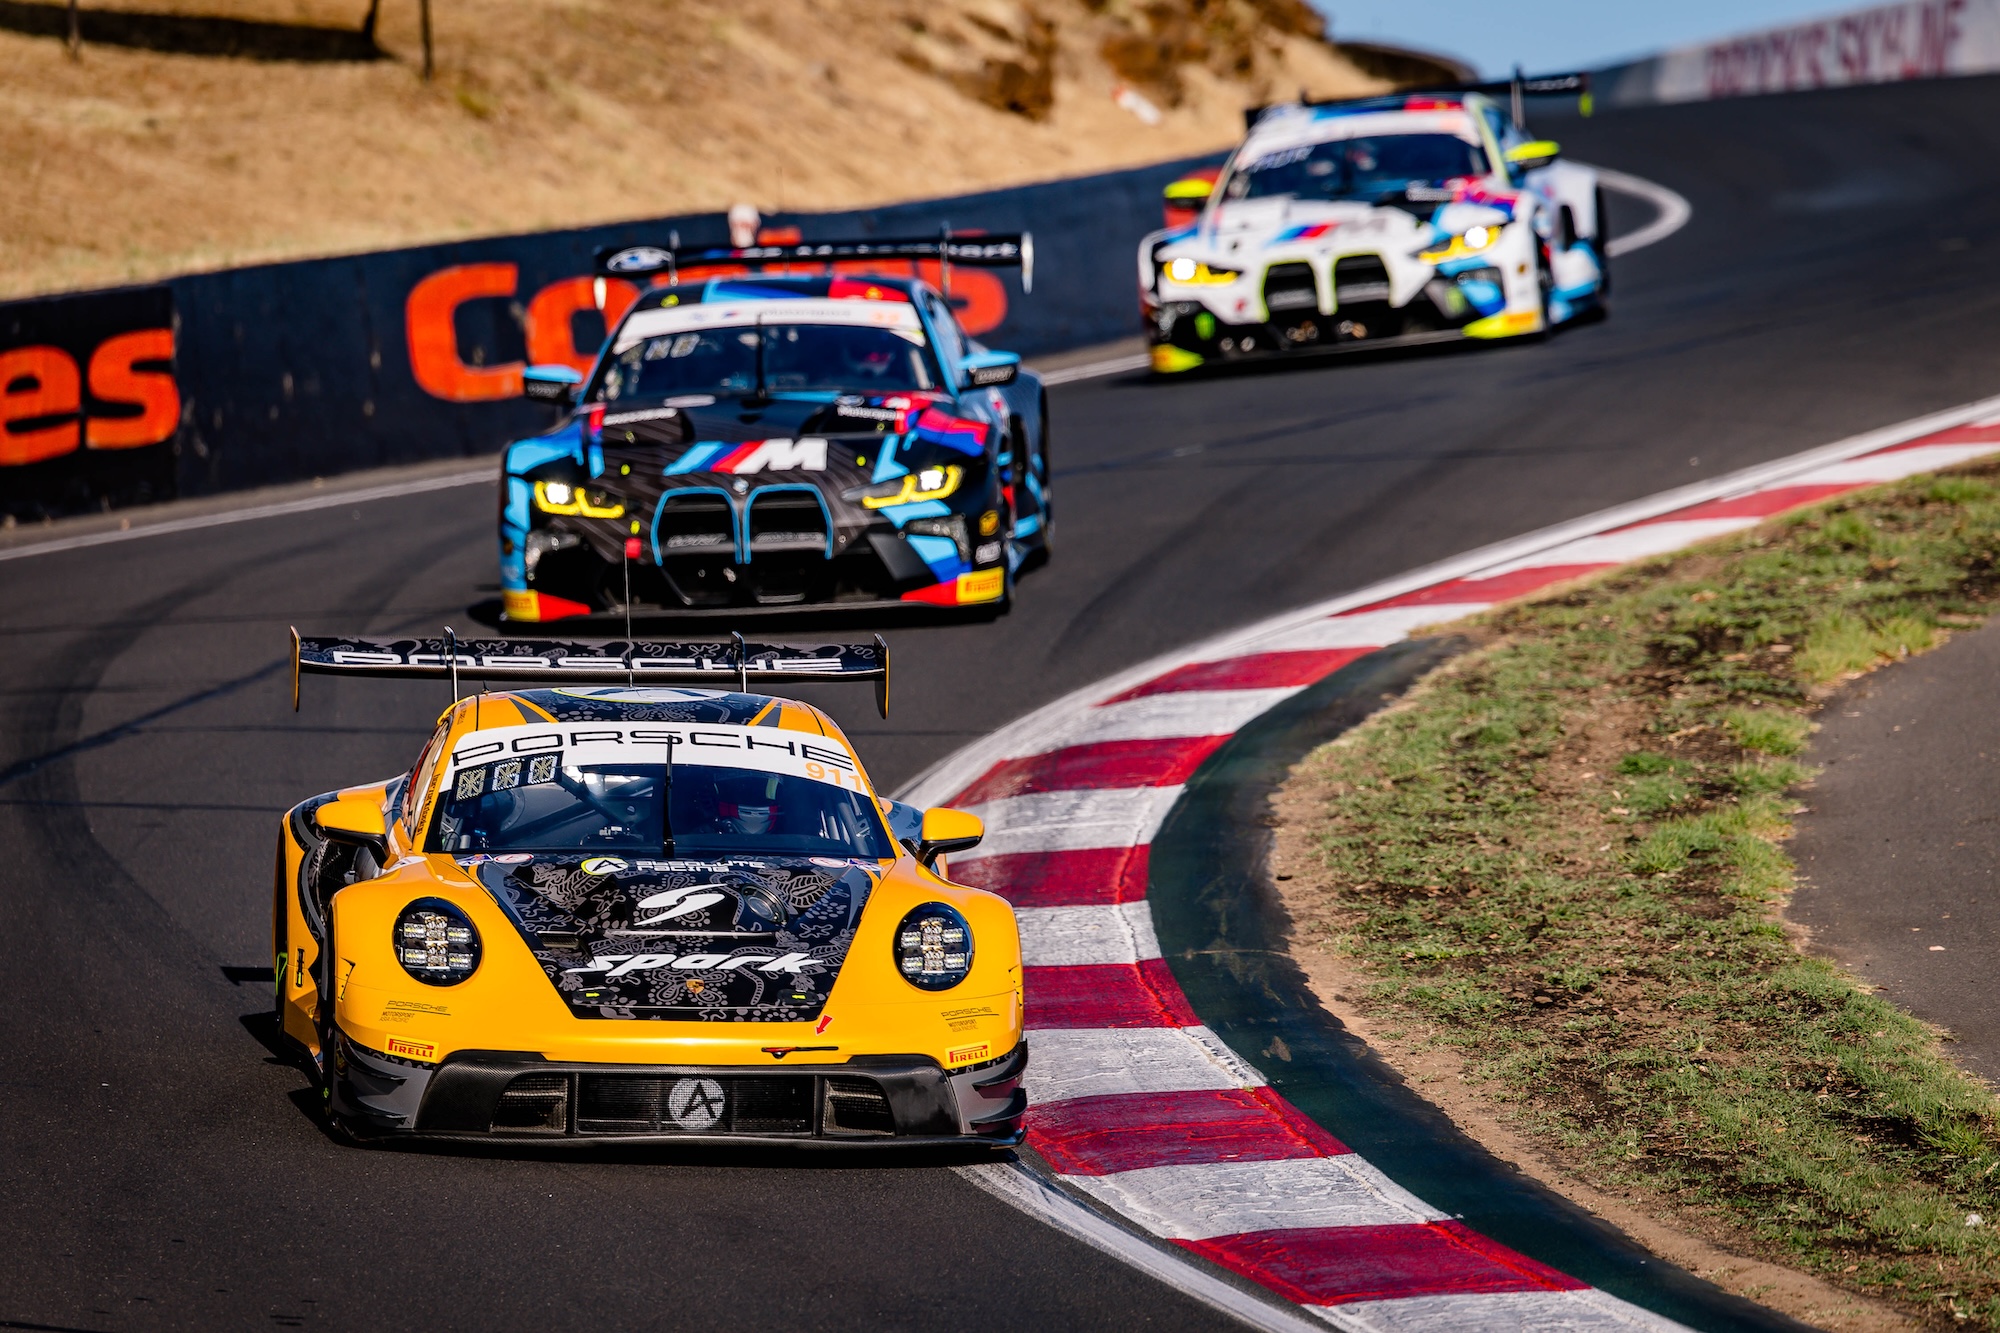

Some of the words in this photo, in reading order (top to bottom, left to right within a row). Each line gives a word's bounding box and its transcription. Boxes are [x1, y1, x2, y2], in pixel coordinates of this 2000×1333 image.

[333, 650, 843, 671] PORSCHE
[452, 730, 854, 772] PORSCHE
[805, 762, 864, 792] 911
[565, 952, 824, 977] spark
[387, 1000, 448, 1012] PORSCHE
[941, 1007, 992, 1017] PORSCHE
[388, 1038, 434, 1058] PIRELLI
[949, 1045, 988, 1063] PIRELLI
